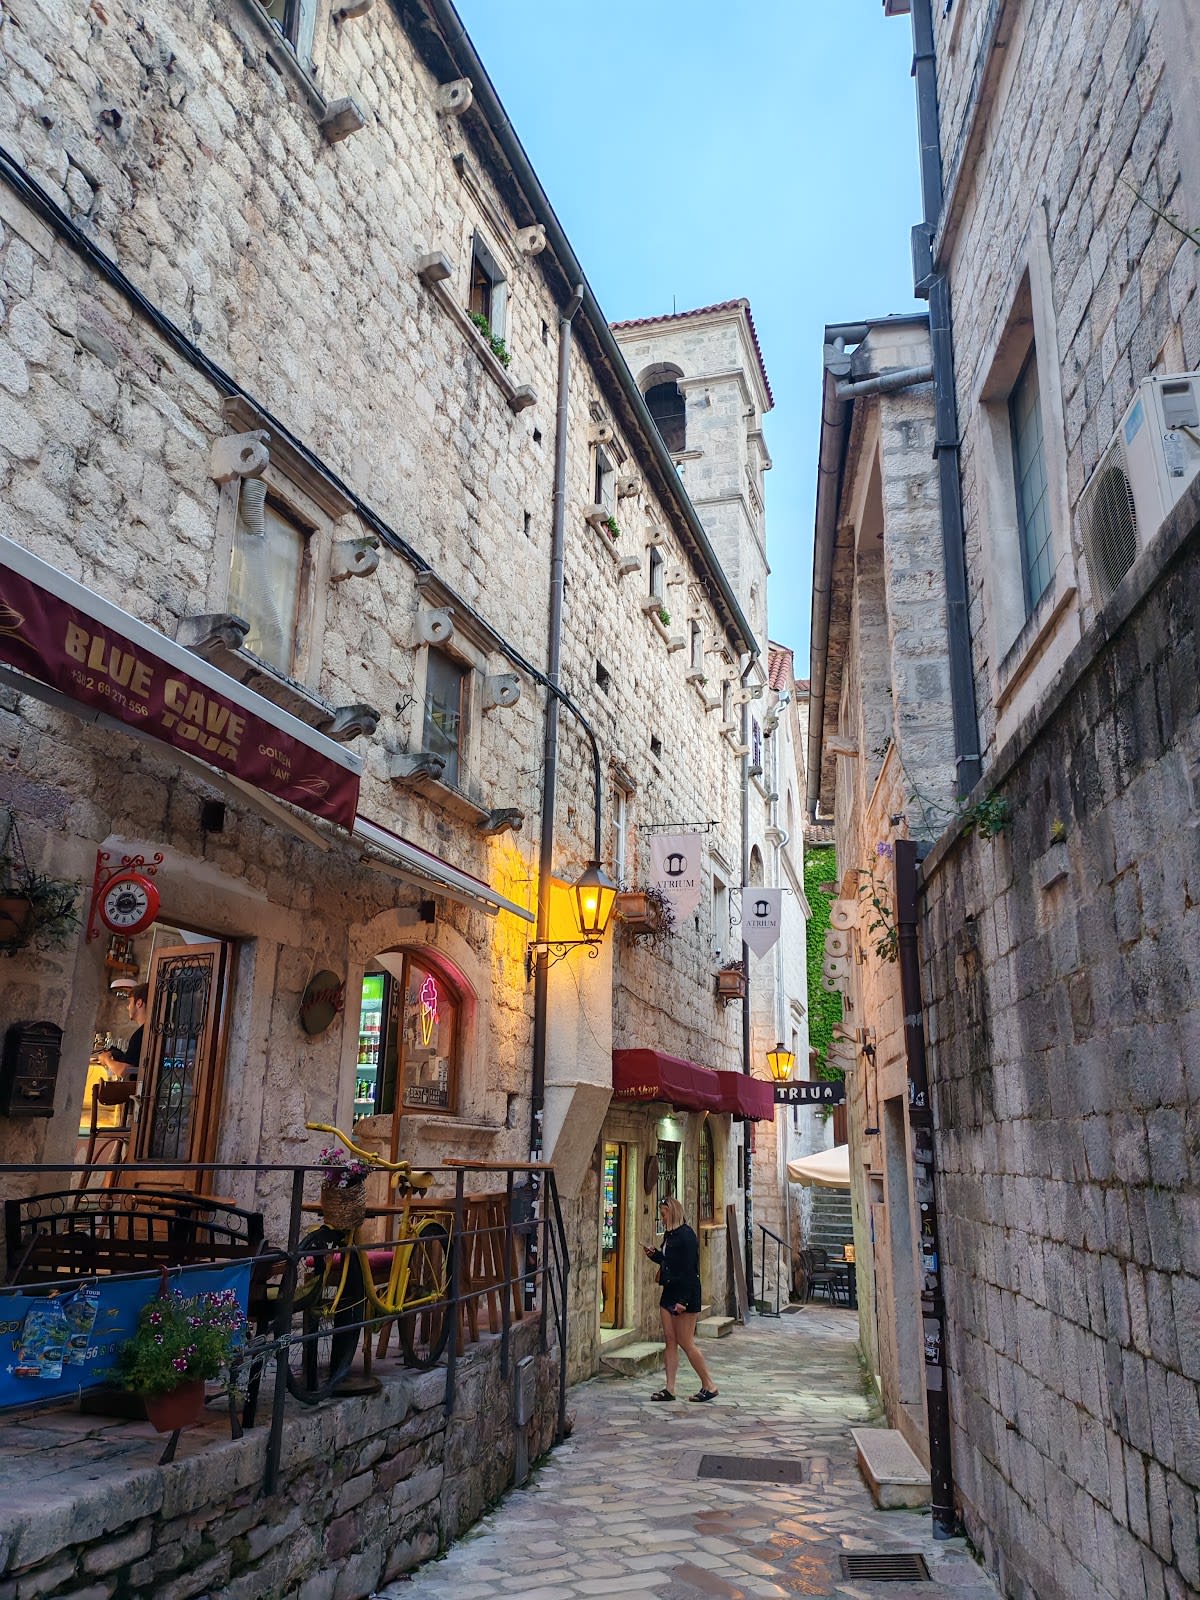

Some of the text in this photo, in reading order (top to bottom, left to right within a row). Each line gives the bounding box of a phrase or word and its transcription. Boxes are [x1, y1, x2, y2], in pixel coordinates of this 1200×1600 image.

[64, 620, 247, 747] BLUE CAVE
[160, 709, 240, 763] TOUR
[258, 743, 292, 769] GOLDEN
[655, 879, 694, 889] ATRIUM
[746, 919, 777, 927] ATRIUM
